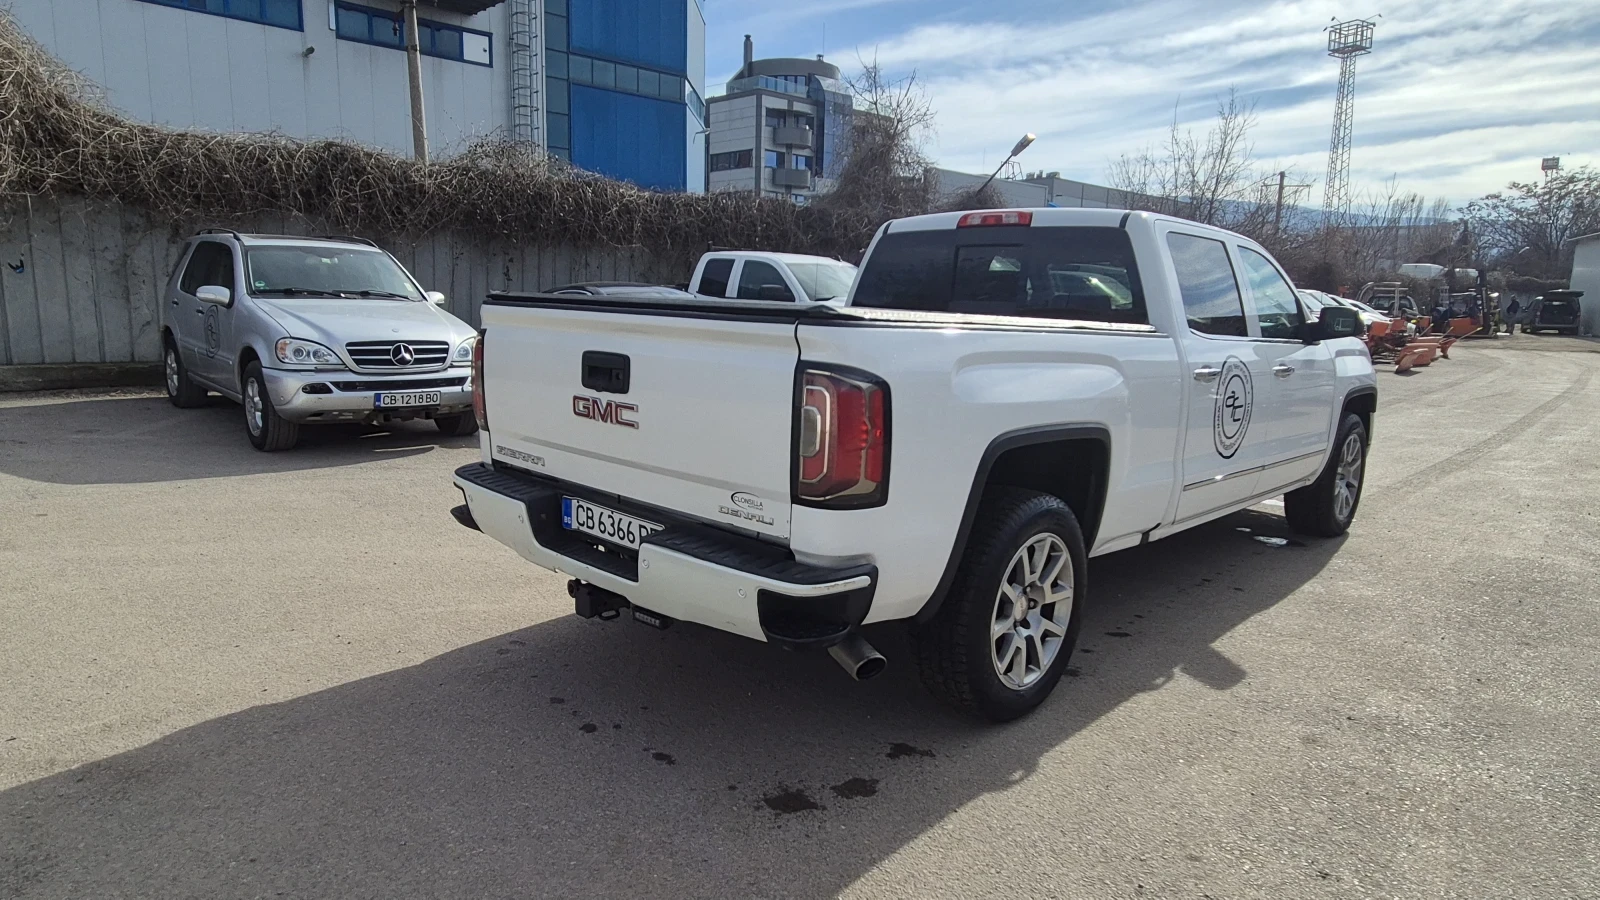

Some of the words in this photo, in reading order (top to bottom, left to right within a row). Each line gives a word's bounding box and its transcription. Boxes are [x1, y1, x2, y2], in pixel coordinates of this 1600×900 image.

[572, 394, 639, 430] GMC
[496, 444, 546, 467] SIERRA
[598, 511, 636, 544] 6366
[718, 505, 775, 526] DENALI
